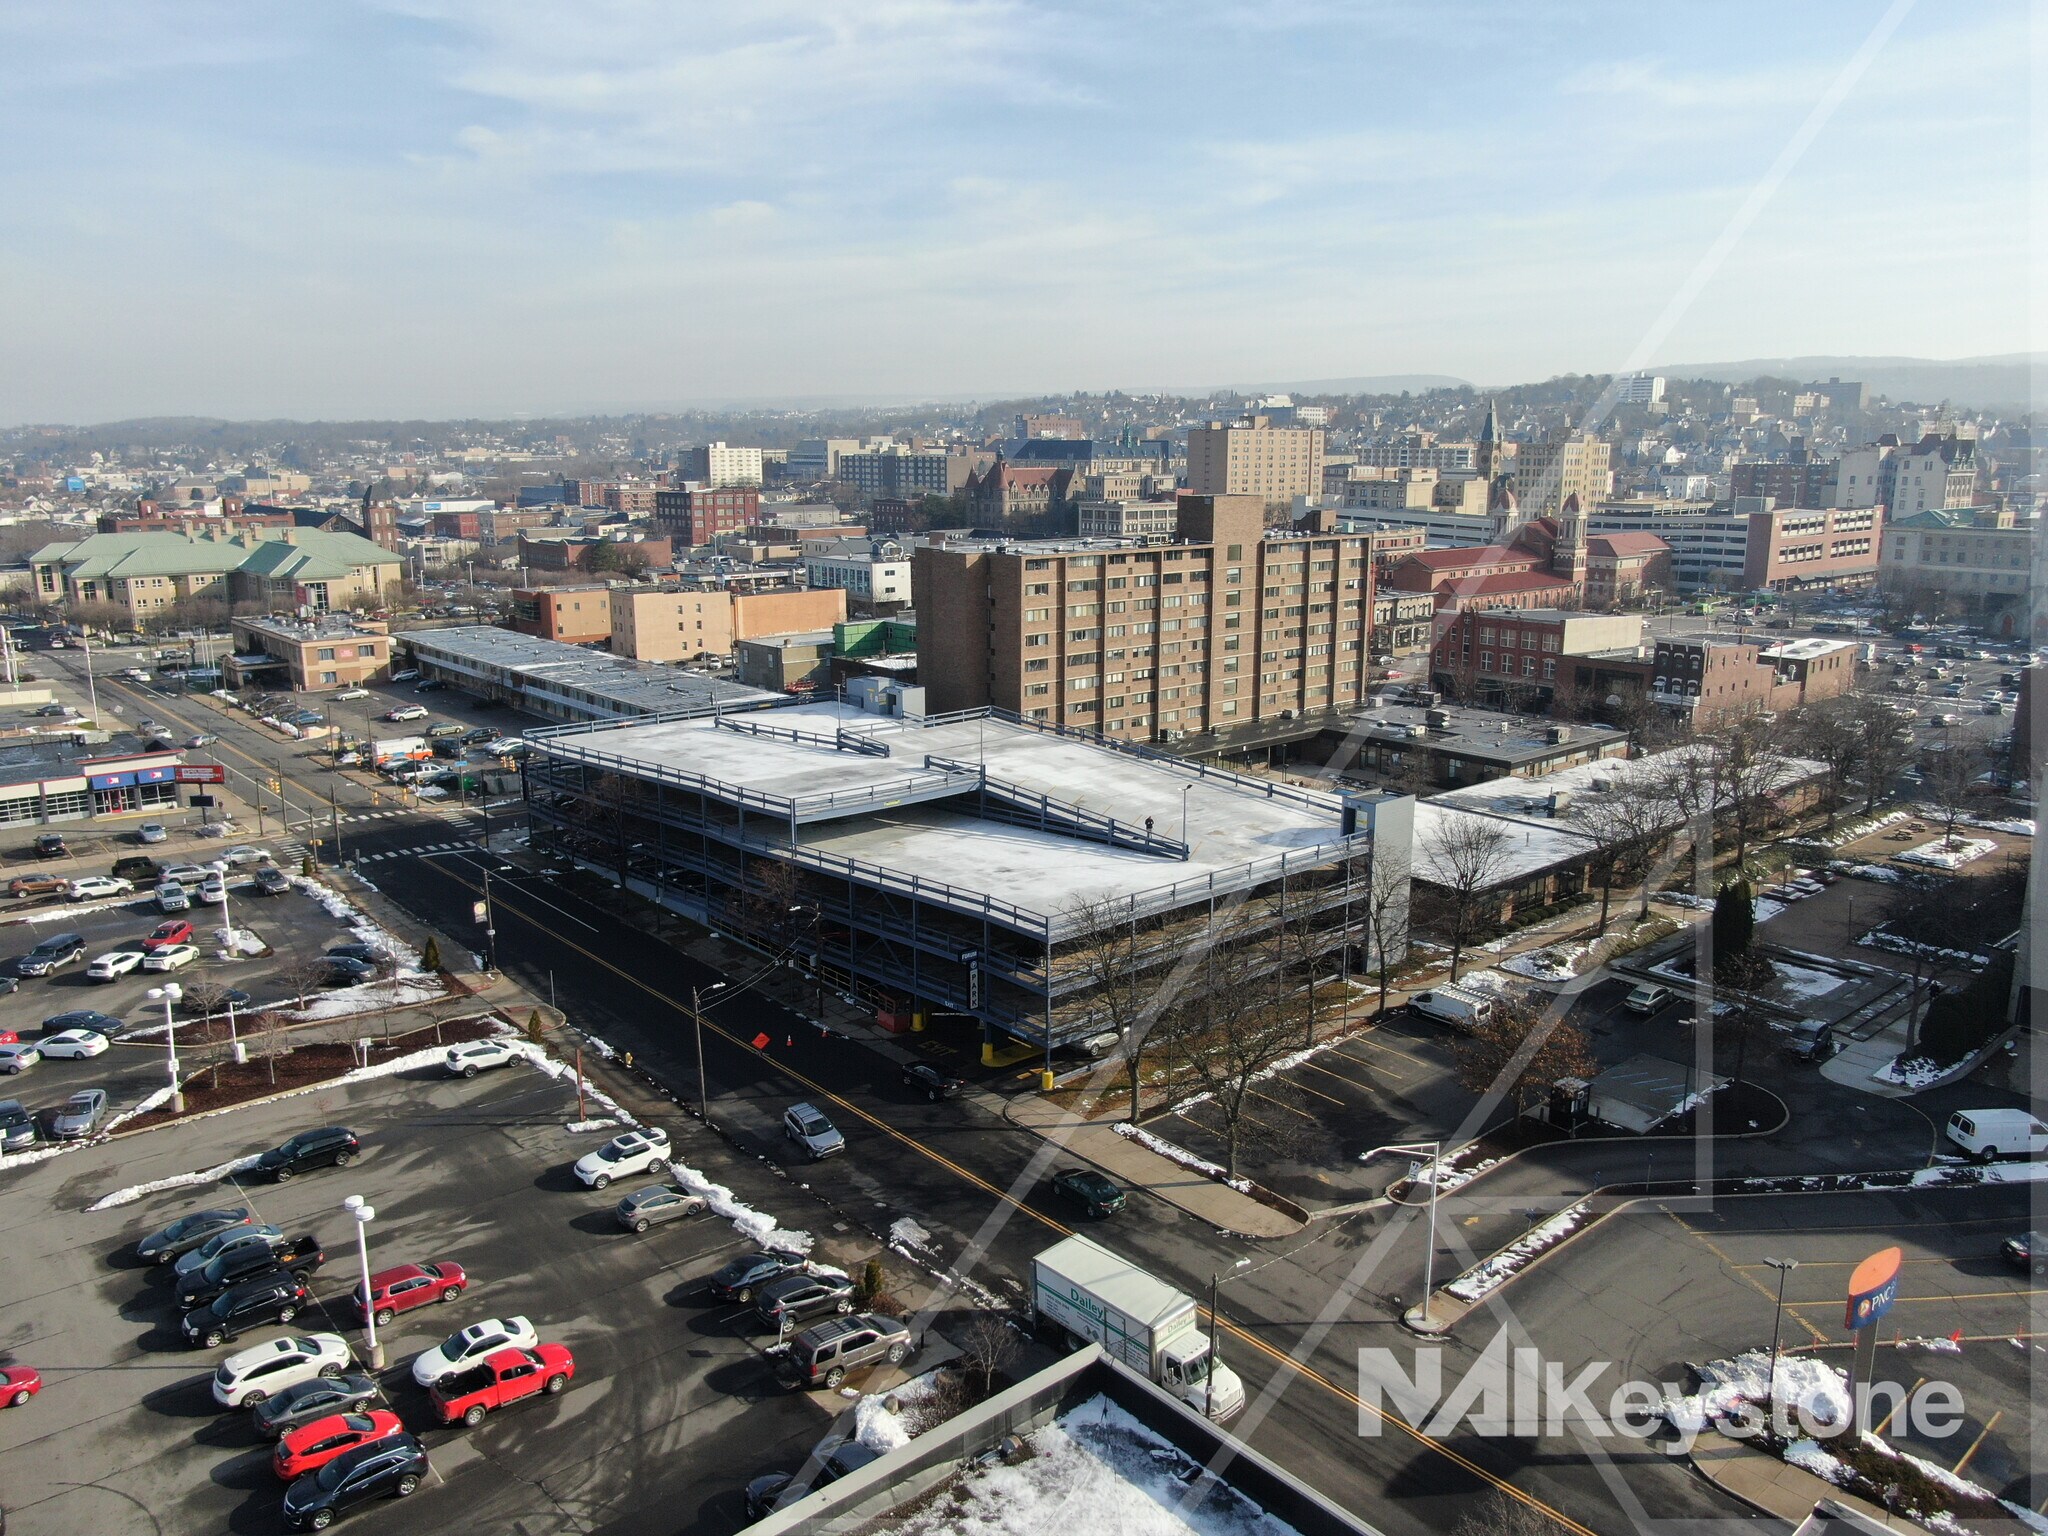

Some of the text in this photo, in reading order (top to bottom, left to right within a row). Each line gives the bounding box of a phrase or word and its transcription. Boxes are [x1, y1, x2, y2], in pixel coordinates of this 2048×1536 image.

[1070, 1287, 1104, 1319] Dailey
[1871, 1285, 1892, 1312] PNC
[1167, 1314, 1188, 1334] Dailey
